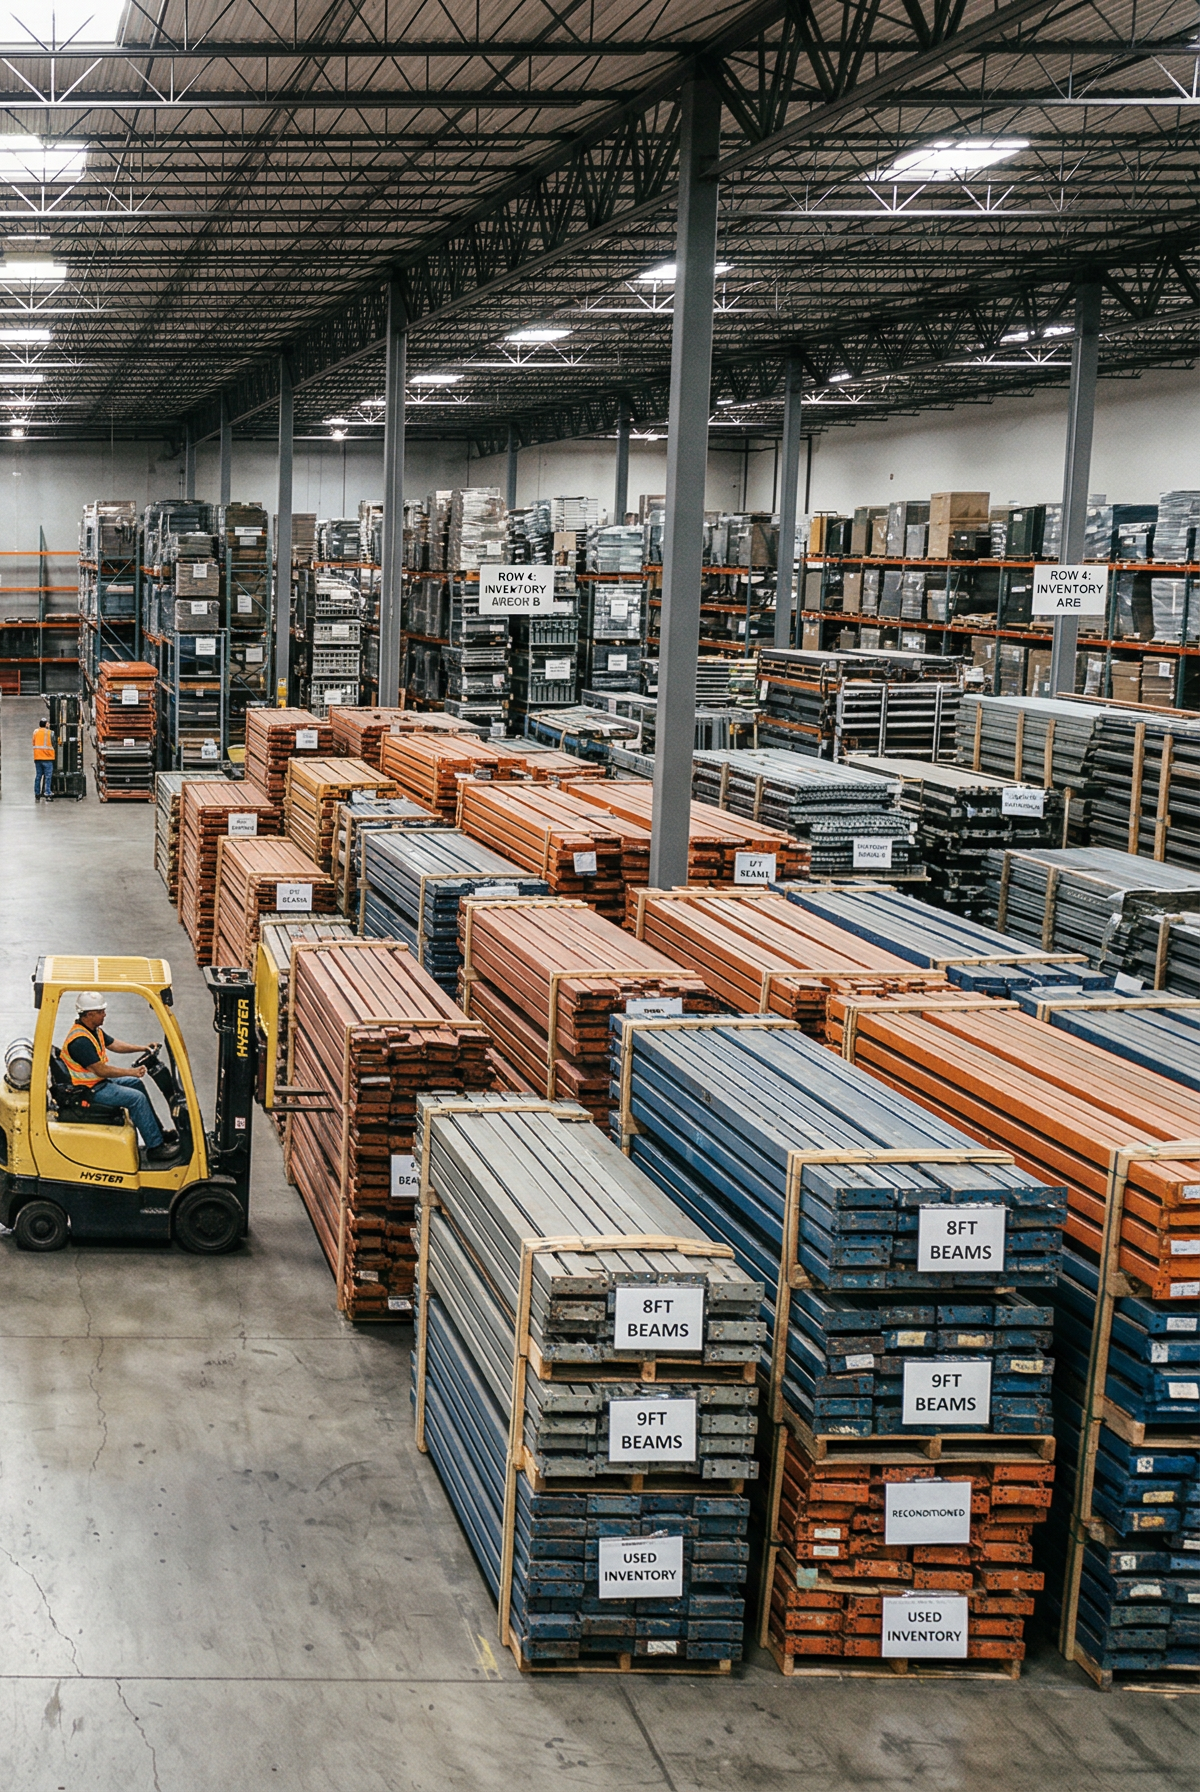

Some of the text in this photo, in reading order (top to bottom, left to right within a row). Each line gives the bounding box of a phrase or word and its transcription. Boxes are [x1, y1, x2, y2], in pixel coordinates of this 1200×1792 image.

[498, 572, 525, 582] ROW
[1050, 570, 1092, 581] ROW 4:
[1036, 584, 1104, 594] INVENTORY
[532, 597, 541, 607] B
[1056, 598, 1081, 608] ARE
[236, 998, 249, 1058] HYSTER
[80, 1171, 124, 1184] HYSTER
[946, 1220, 978, 1235] 8FT
[930, 1245, 992, 1260] BEAMS
[642, 1299, 674, 1314] 8FT
[627, 1323, 689, 1338] BEAMS
[931, 1373, 962, 1388] 9FT
[915, 1397, 976, 1411] BEAMS
[637, 1411, 667, 1426] 9FT
[621, 1434, 683, 1449] BEAMS
[623, 1552, 657, 1564] USED
[604, 1569, 677, 1582] INVENTORY
[907, 1611, 942, 1623] USED
[887, 1630, 962, 1642] INVENTORY
